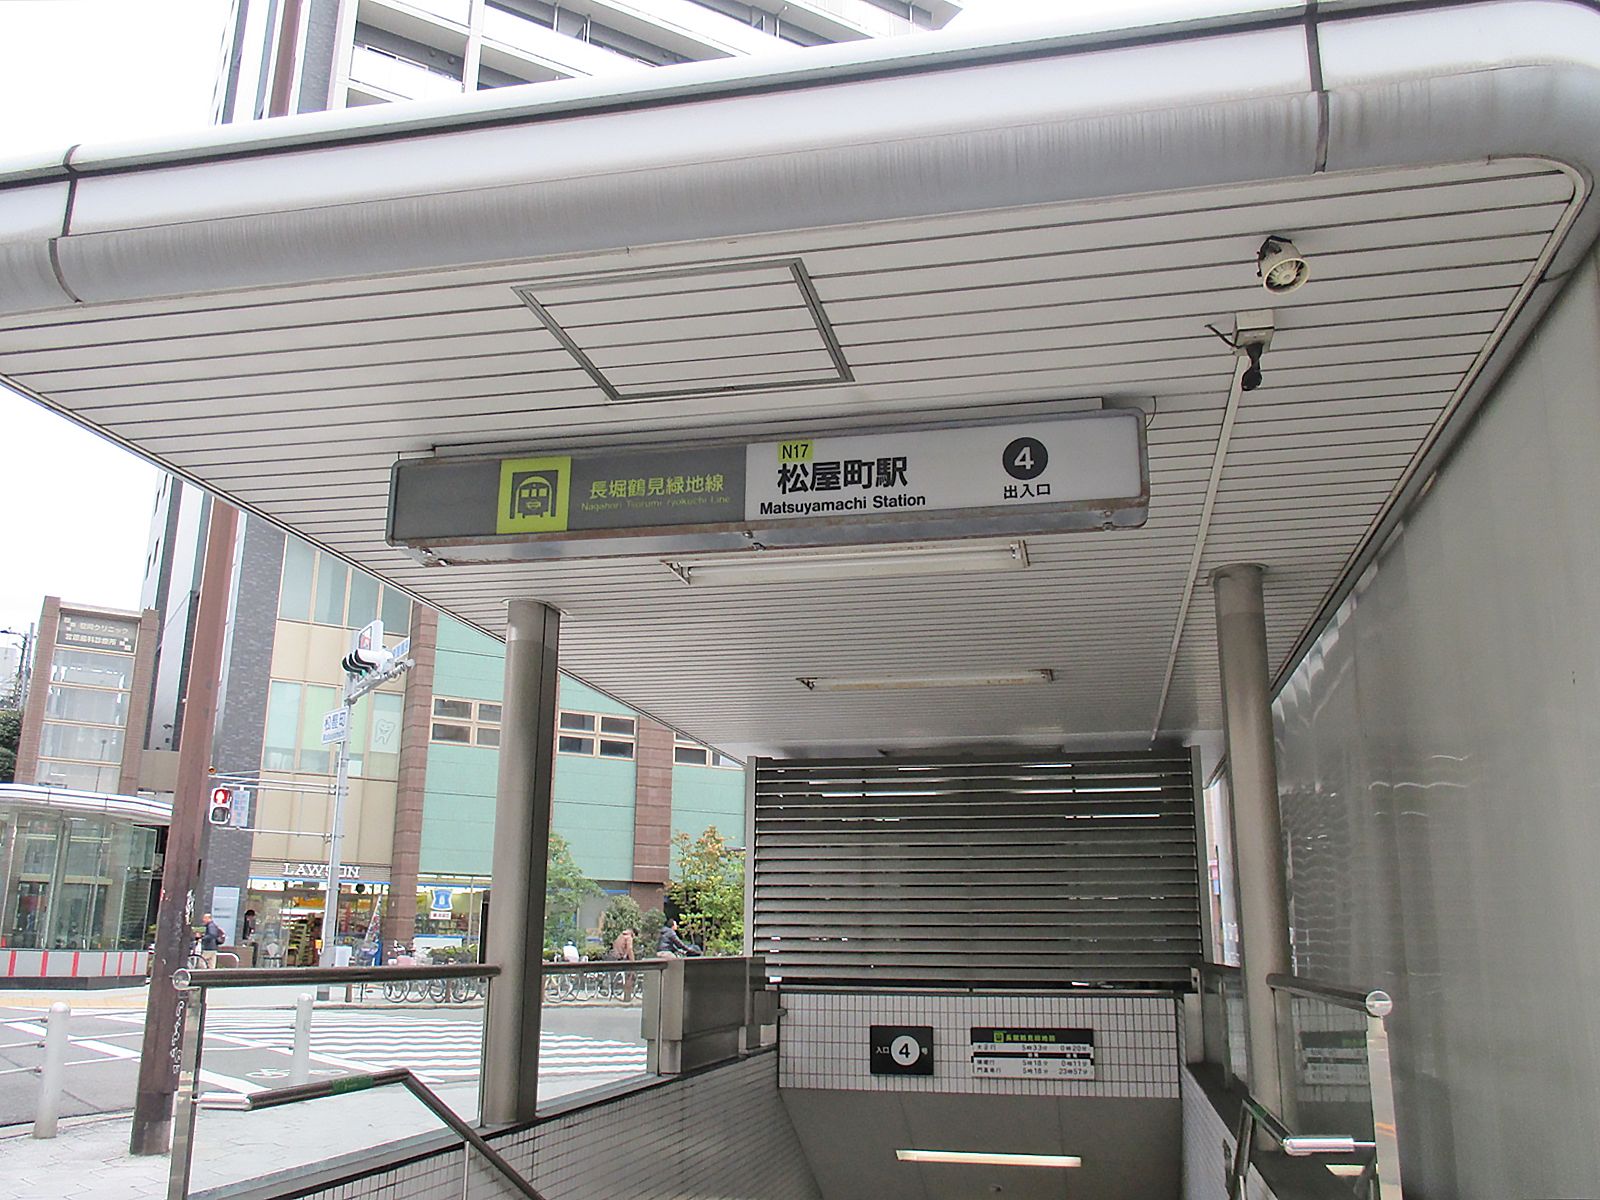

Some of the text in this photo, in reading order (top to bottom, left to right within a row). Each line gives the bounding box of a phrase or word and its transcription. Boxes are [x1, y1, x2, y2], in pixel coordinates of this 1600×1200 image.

[782, 444, 809, 459] N17
[1014, 446, 1035, 470] 4
[590, 474, 724, 499] 長堀鶴見緑地線
[777, 456, 908, 495] 松屋町駅
[1004, 484, 1051, 500] 出入口
[760, 493, 926, 515] Matsuyamachi Station
[898, 1043, 911, 1059] 4
